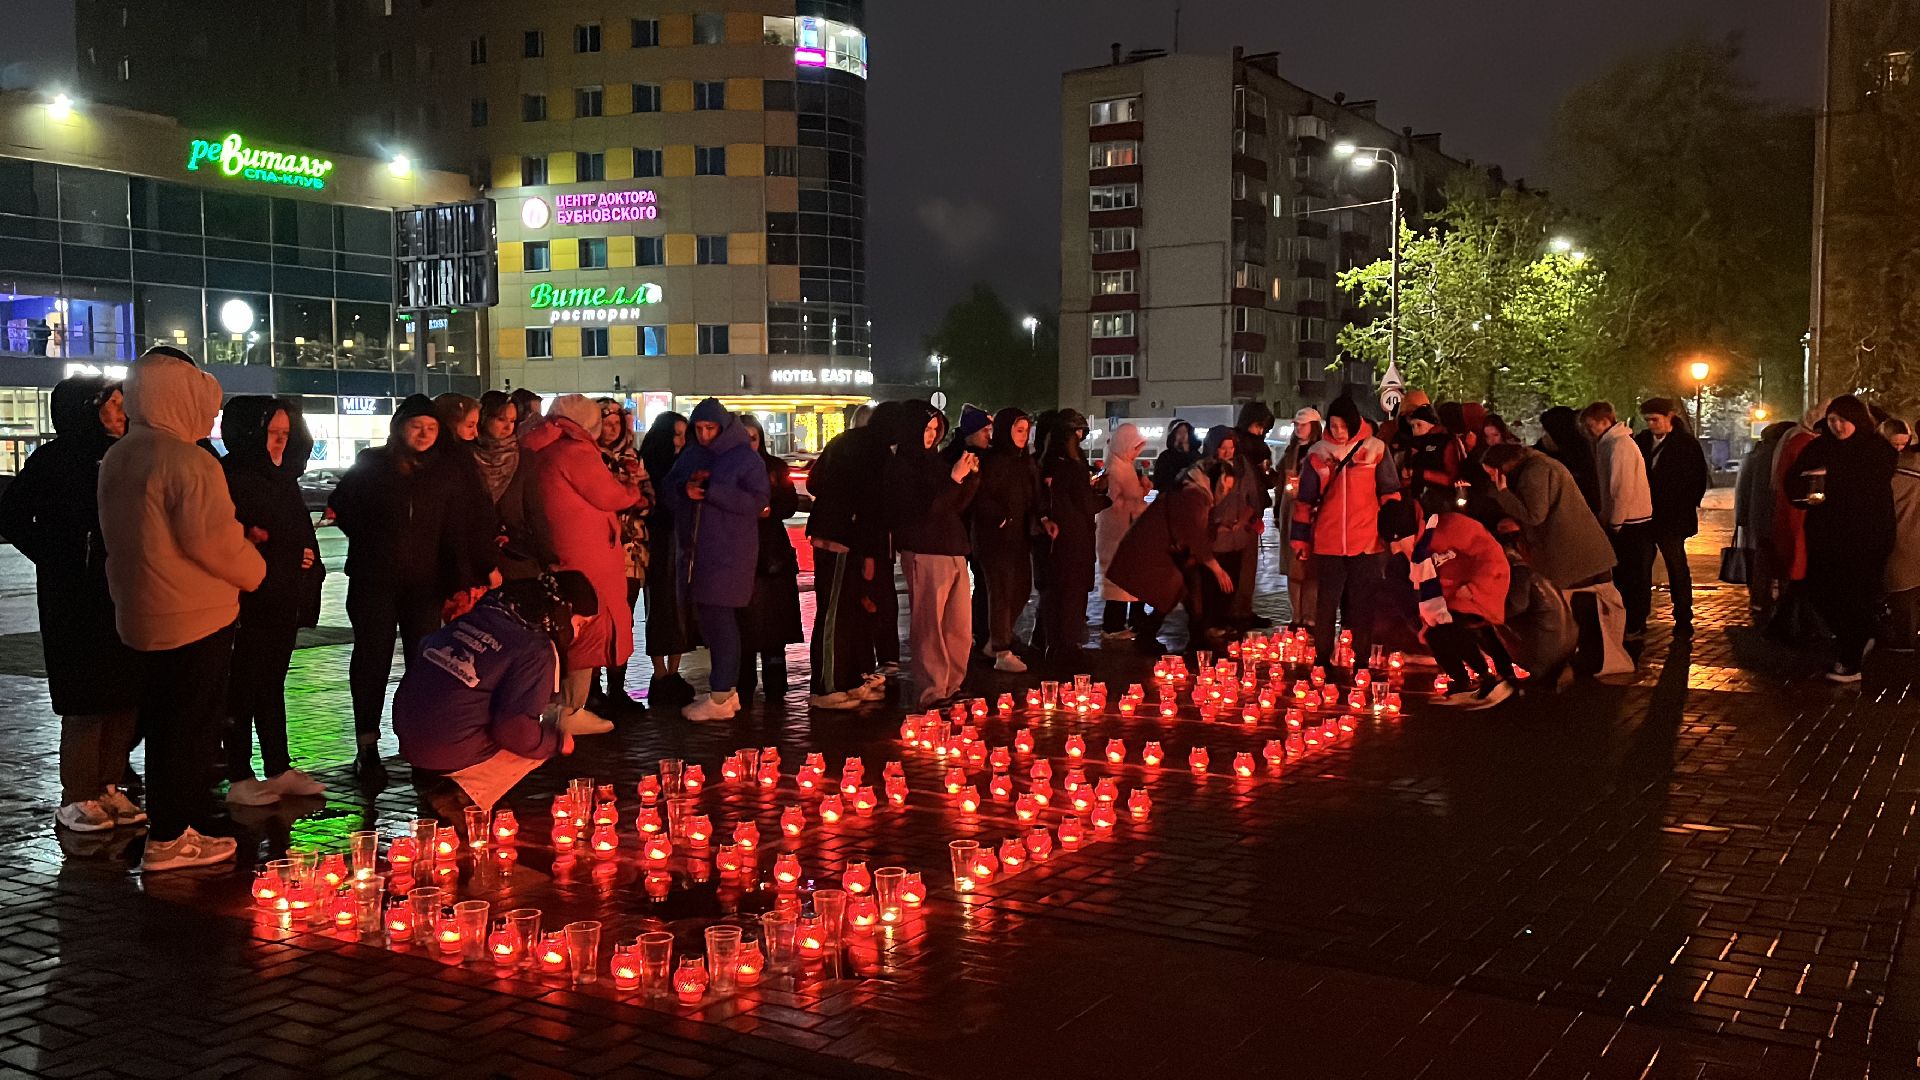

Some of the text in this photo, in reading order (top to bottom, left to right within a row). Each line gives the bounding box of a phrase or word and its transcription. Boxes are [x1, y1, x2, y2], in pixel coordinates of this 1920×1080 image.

[243, 168, 325, 190] СПА-КЛУБ
[556, 191, 657, 208] ЦЕНТР ДОКТОРА
[557, 206, 657, 224] БУБНОВСКОГО
[550, 308, 641, 323] ресторан
[771, 369, 816, 383] HOTEL
[820, 368, 853, 383] EAST
[342, 397, 377, 411] MIUZ
[1385, 396, 1399, 406] 40
